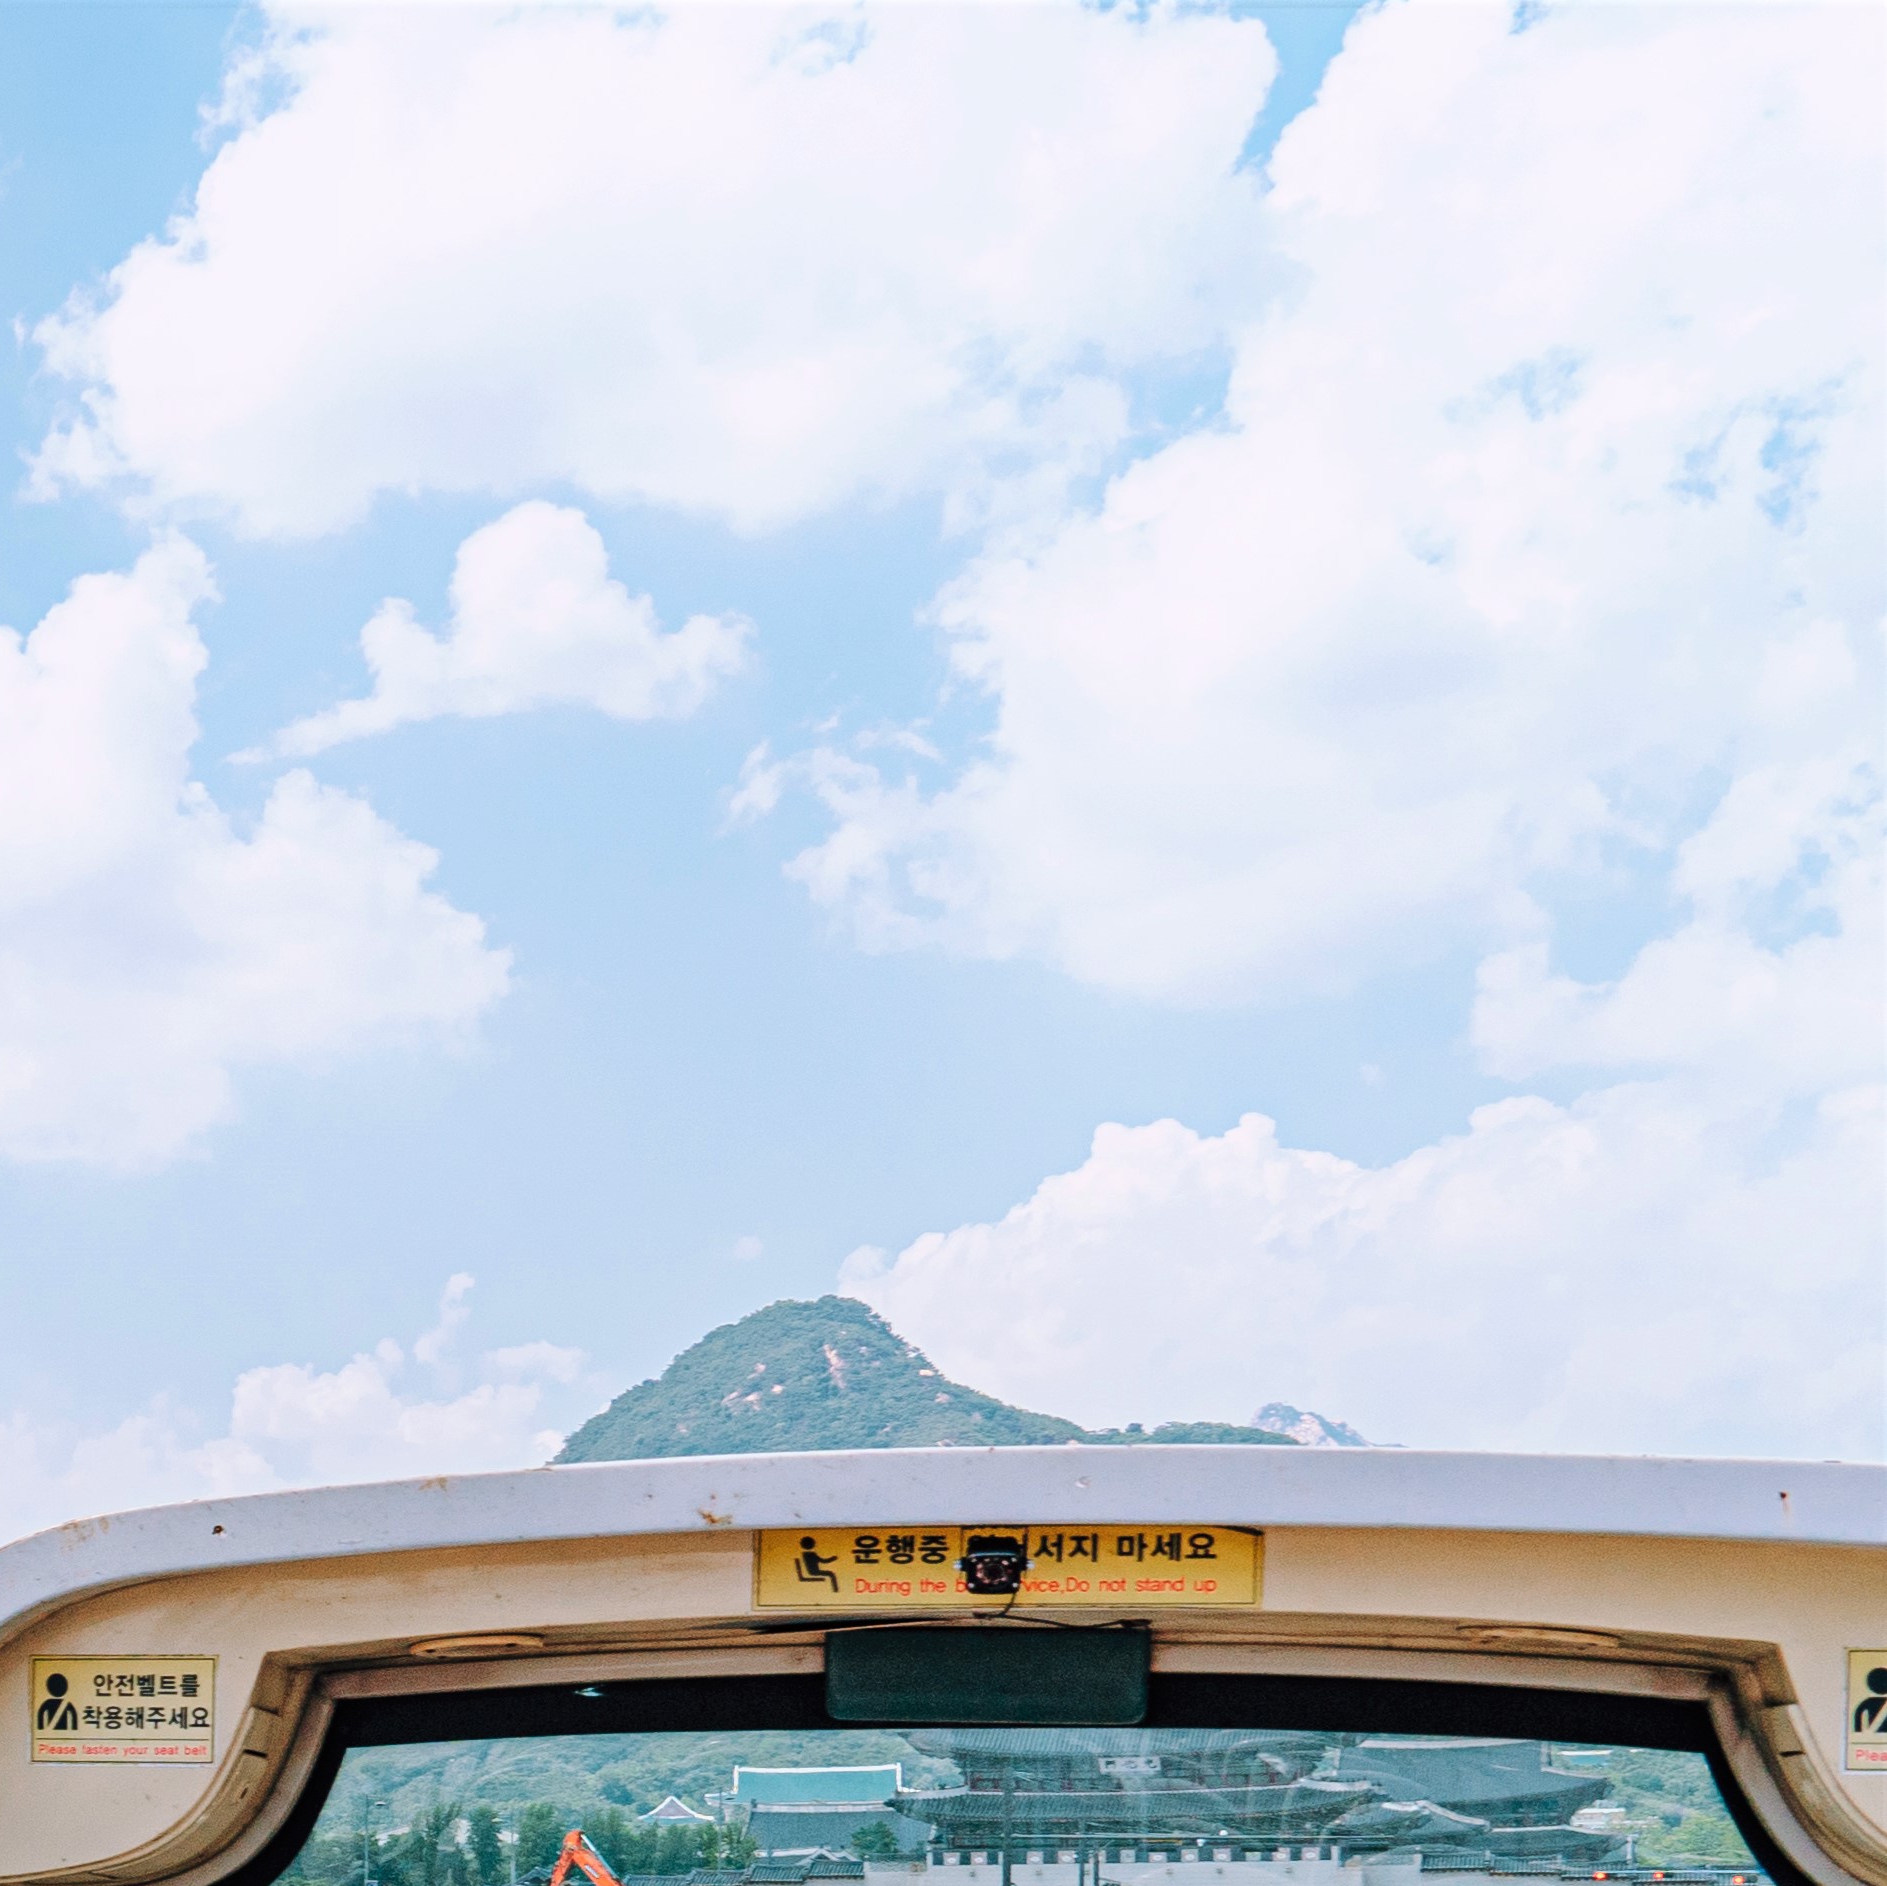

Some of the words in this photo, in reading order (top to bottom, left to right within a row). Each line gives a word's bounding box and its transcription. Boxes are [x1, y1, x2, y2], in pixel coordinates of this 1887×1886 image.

[851, 1534, 949, 1565] 운행중
[1116, 1531, 1218, 1563] 마세요
[854, 1577, 913, 1596] During
[919, 1578, 947, 1595] the
[1098, 1578, 1127, 1594] not
[1135, 1576, 1185, 1593] stand
[1193, 1579, 1218, 1597] up
[92, 1673, 201, 1698] 안전벨트를
[82, 1705, 211, 1731] 착용해주세요
[37, 1744, 77, 1756] Please
[82, 1744, 118, 1756] fasten
[123, 1745, 149, 1758] your
[154, 1744, 179, 1756] seat
[184, 1744, 208, 1757] belt
